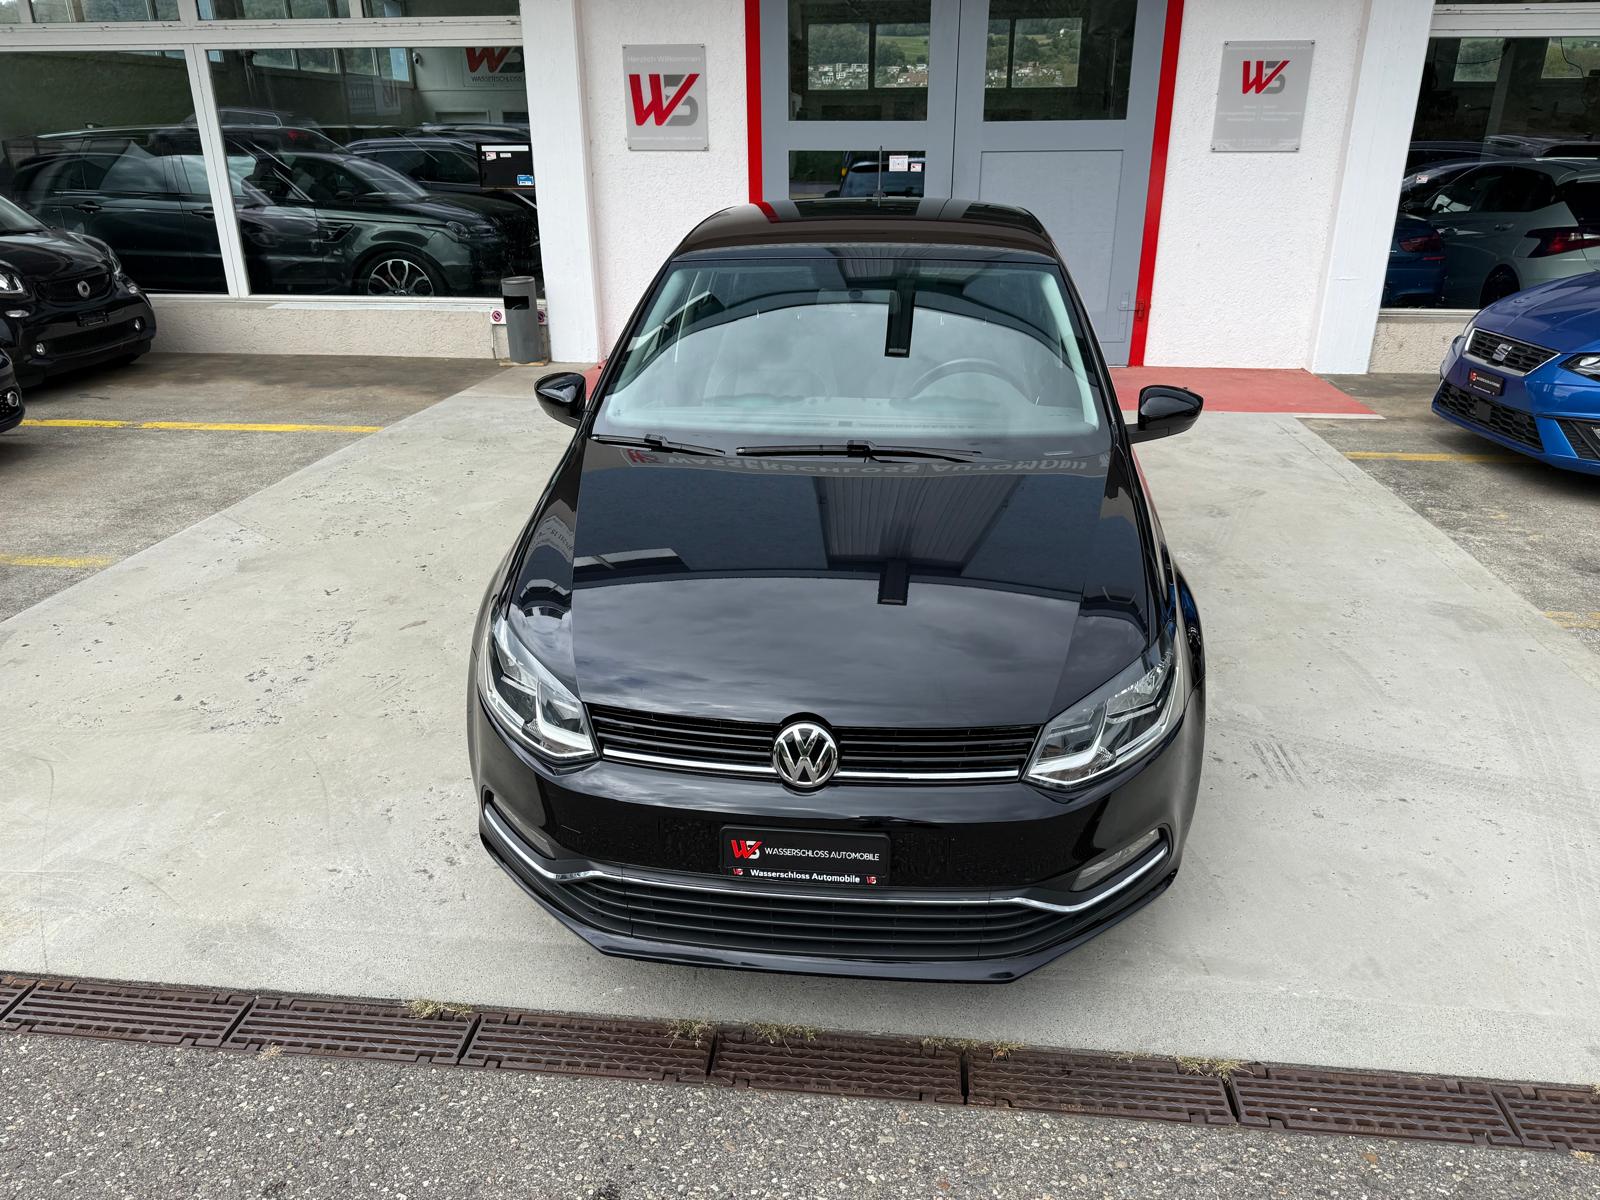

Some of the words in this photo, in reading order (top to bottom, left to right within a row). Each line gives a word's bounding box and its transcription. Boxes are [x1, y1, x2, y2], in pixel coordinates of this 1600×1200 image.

[765, 847, 829, 858] WASSERSCHLOSS
[830, 851, 880, 861] AUTOMOBILE
[750, 869, 810, 880] Wasserschloss
[811, 873, 860, 884] Automobile
